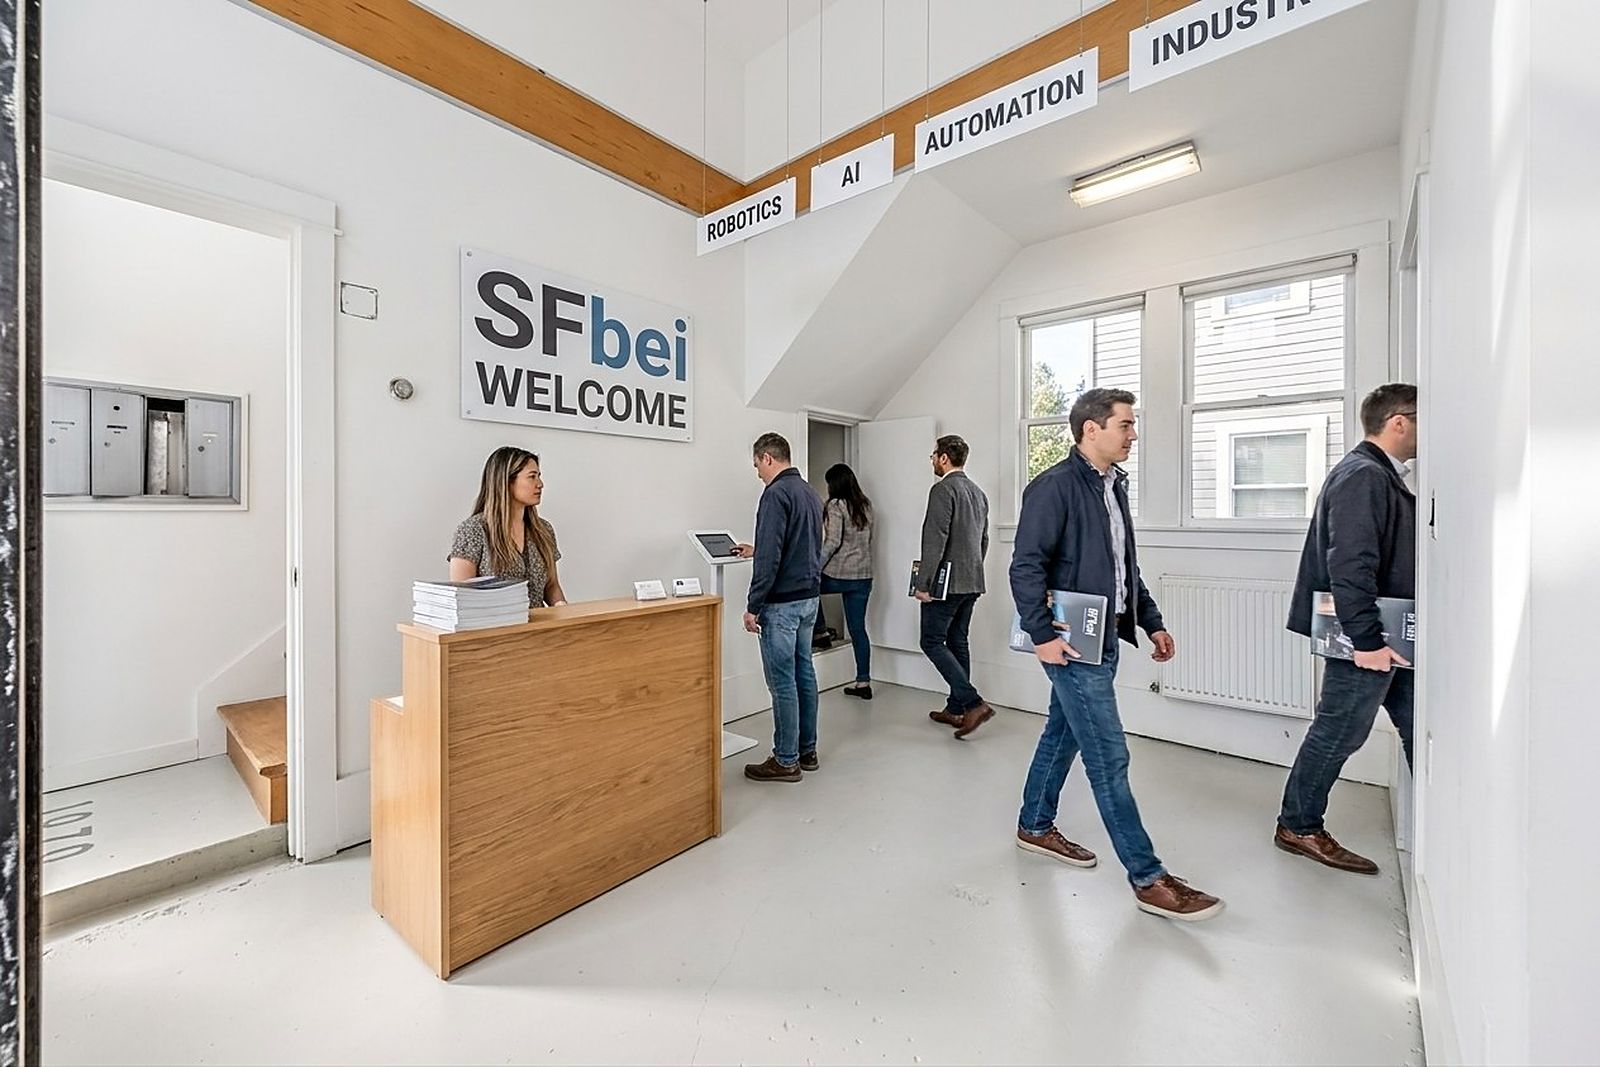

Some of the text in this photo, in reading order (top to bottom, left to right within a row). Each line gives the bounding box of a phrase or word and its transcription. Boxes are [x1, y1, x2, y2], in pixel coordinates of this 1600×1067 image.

[1152, 0, 1312, 66] INDUS
[924, 70, 1084, 155] AUTOMATION
[841, 161, 861, 188] AI
[707, 195, 782, 242] ROBOTICS
[474, 270, 687, 382] SFbei
[475, 360, 687, 429] WELCOME
